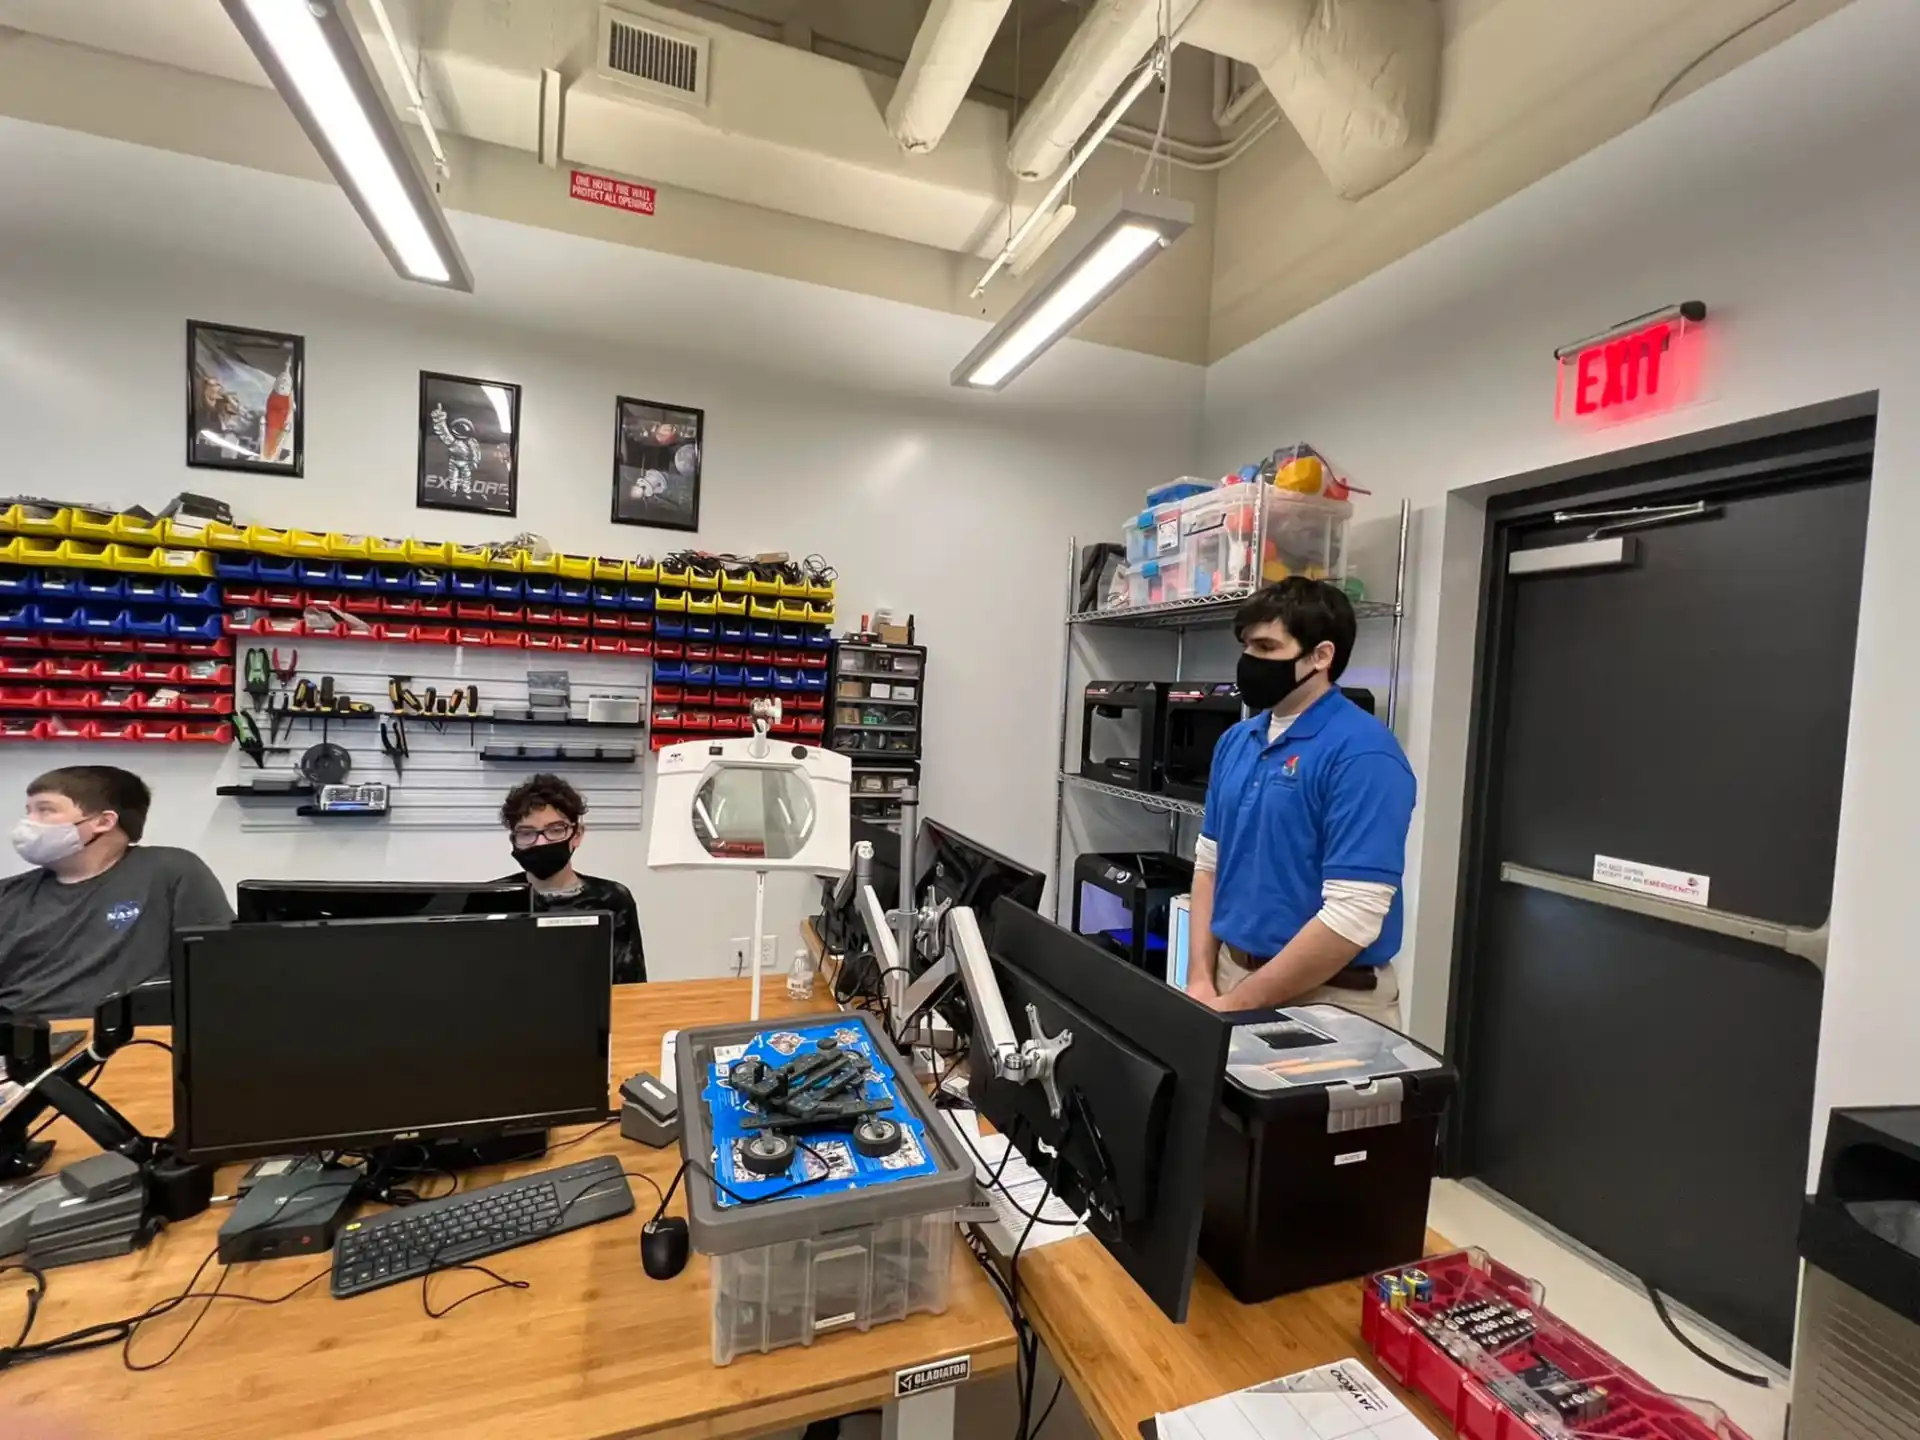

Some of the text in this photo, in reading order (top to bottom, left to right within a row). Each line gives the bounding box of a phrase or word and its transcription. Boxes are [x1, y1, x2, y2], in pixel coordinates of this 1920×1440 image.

[572, 185, 654, 212] PROTECT ALL OPENINGS
[576, 175, 651, 201] ONE HOUR FIRE WALL
[1576, 324, 1669, 415] EXIT
[424, 474, 510, 497] EXORE
[914, 1362, 967, 1385] GLADIATOR
